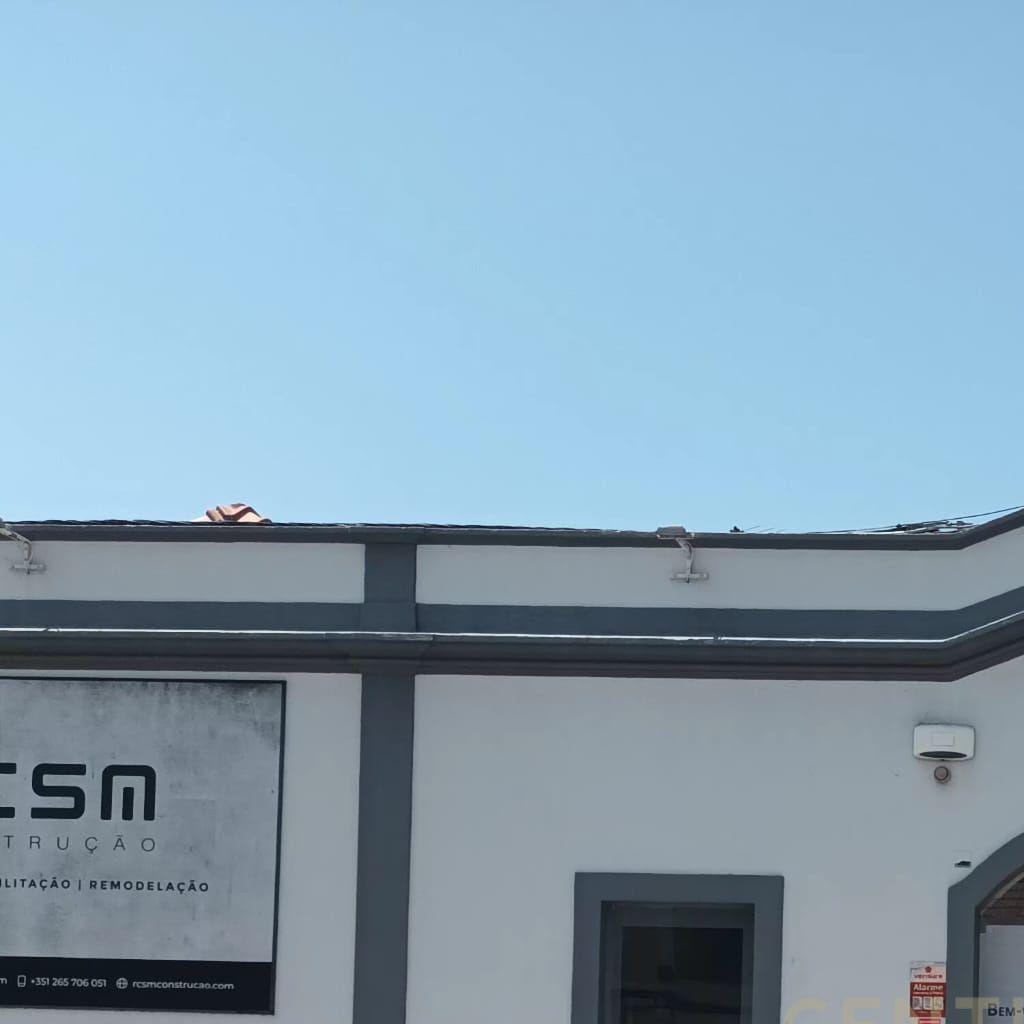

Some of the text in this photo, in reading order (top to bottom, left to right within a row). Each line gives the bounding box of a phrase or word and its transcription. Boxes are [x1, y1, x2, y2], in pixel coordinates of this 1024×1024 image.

[89, 880, 209, 894] REMODELAÇÃO
[31, 977, 50, 986] +351
[52, 978, 69, 987] 265
[71, 978, 89, 988] 706
[91, 979, 107, 988] 051
[132, 980, 235, 990] rcsmconstrucao.com
[913, 983, 944, 991] Alarme
